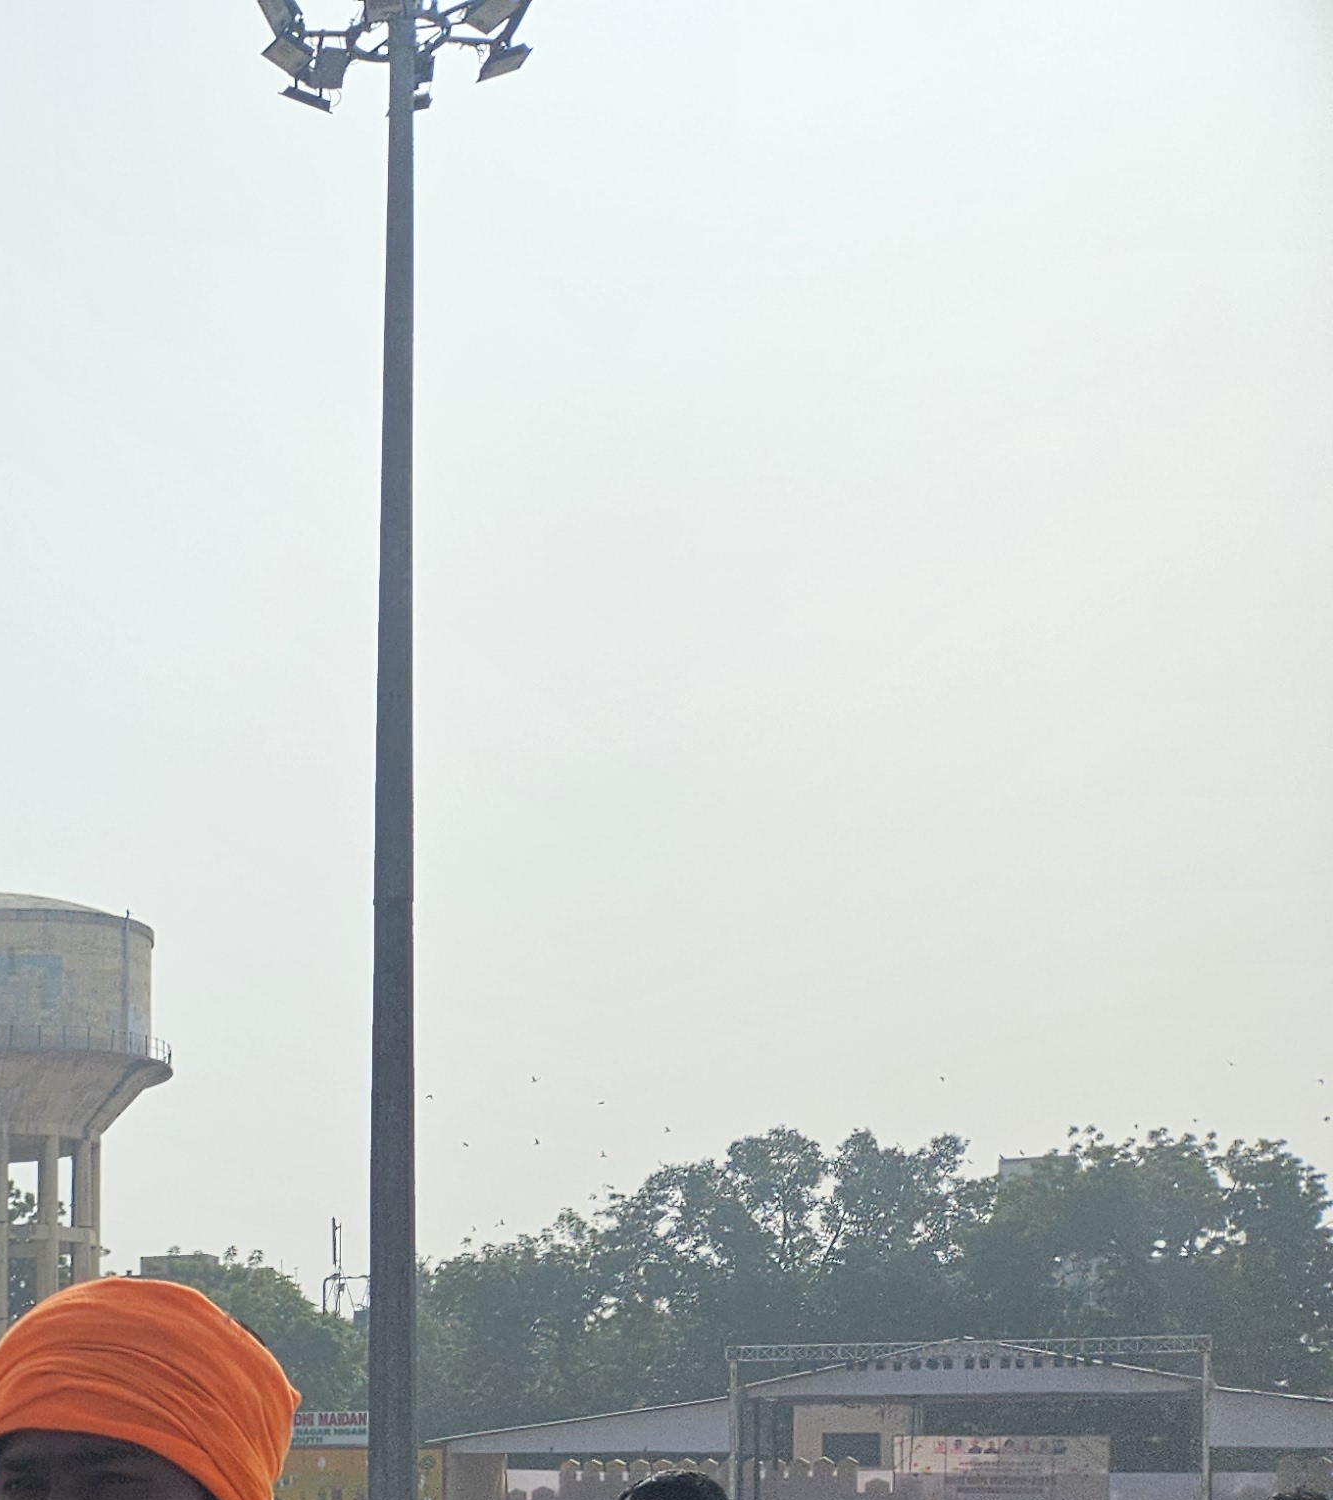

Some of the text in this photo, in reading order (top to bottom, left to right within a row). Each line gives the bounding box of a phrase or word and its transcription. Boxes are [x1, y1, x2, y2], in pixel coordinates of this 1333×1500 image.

[294, 1412, 367, 1426] DHI MAIDAN
[295, 1427, 367, 1436] NAGAR NIGAM
